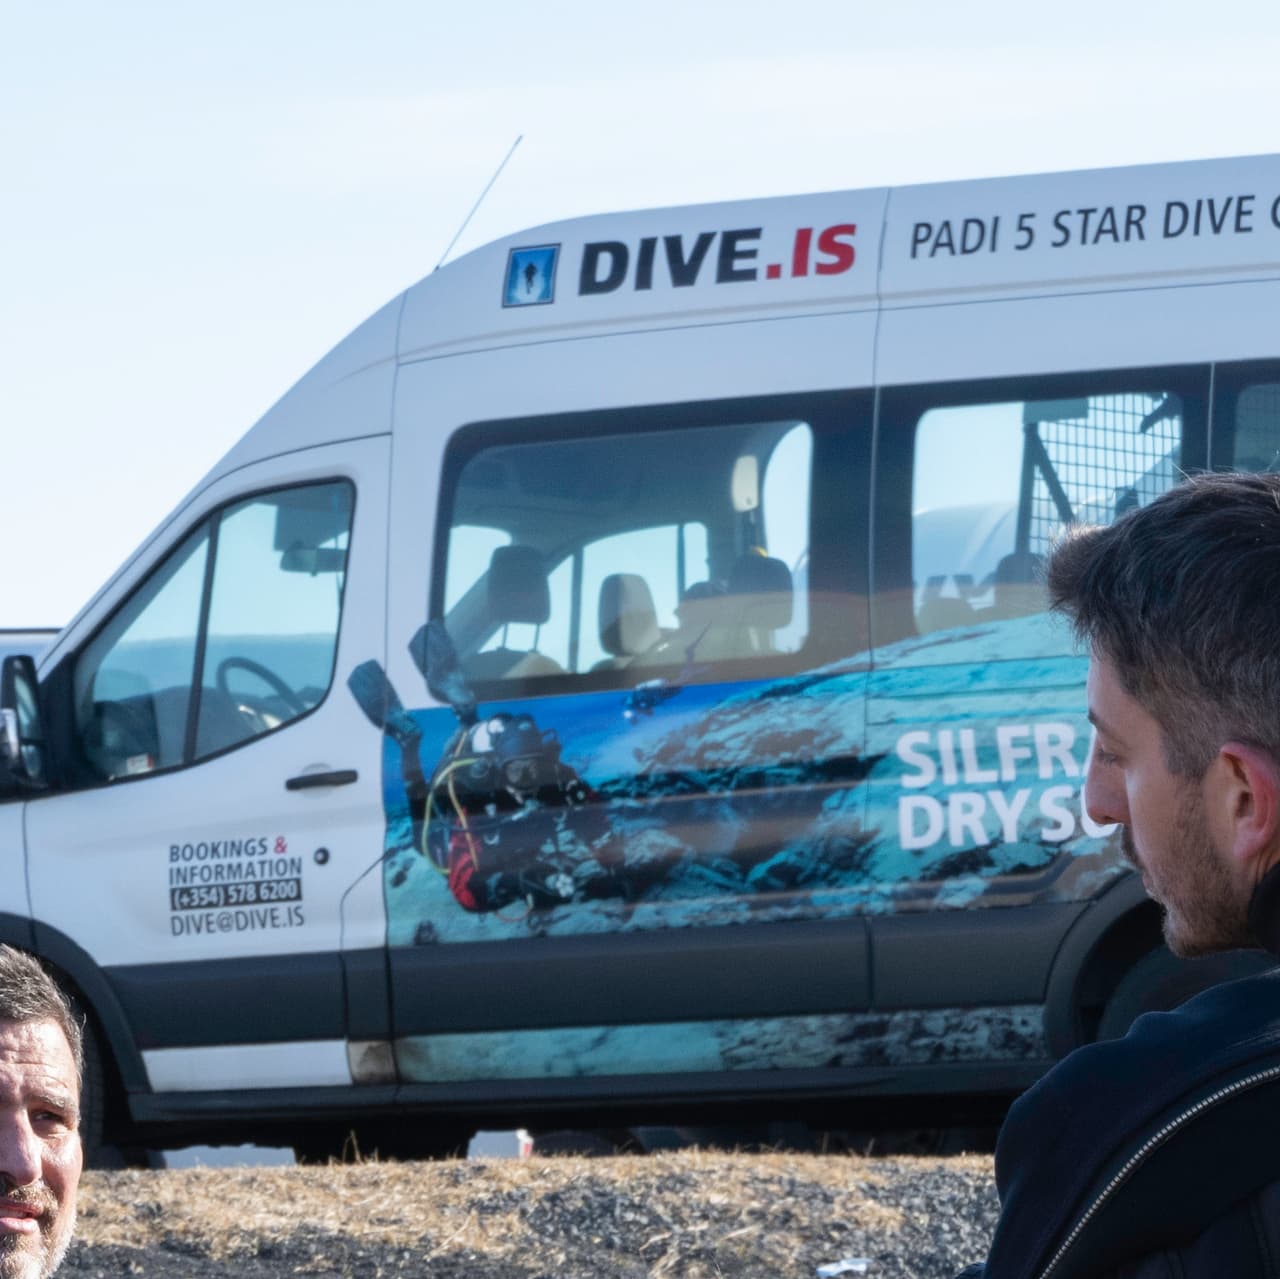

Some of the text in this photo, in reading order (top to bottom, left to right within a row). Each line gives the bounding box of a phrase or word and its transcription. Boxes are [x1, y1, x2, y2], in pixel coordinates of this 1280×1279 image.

[910, 216, 1000, 259] PADI
[1015, 213, 1037, 251] 5
[1051, 204, 1148, 248] STAR
[1163, 195, 1256, 239] DIVE
[577, 223, 857, 297] DIVE.IS
[169, 836, 288, 863] BOOKINGS &
[169, 857, 302, 886] INFORMATION
[227, 882, 257, 904] 578
[260, 880, 298, 900] 6200
[170, 905, 305, 937] DIVE@DIVE.IS
